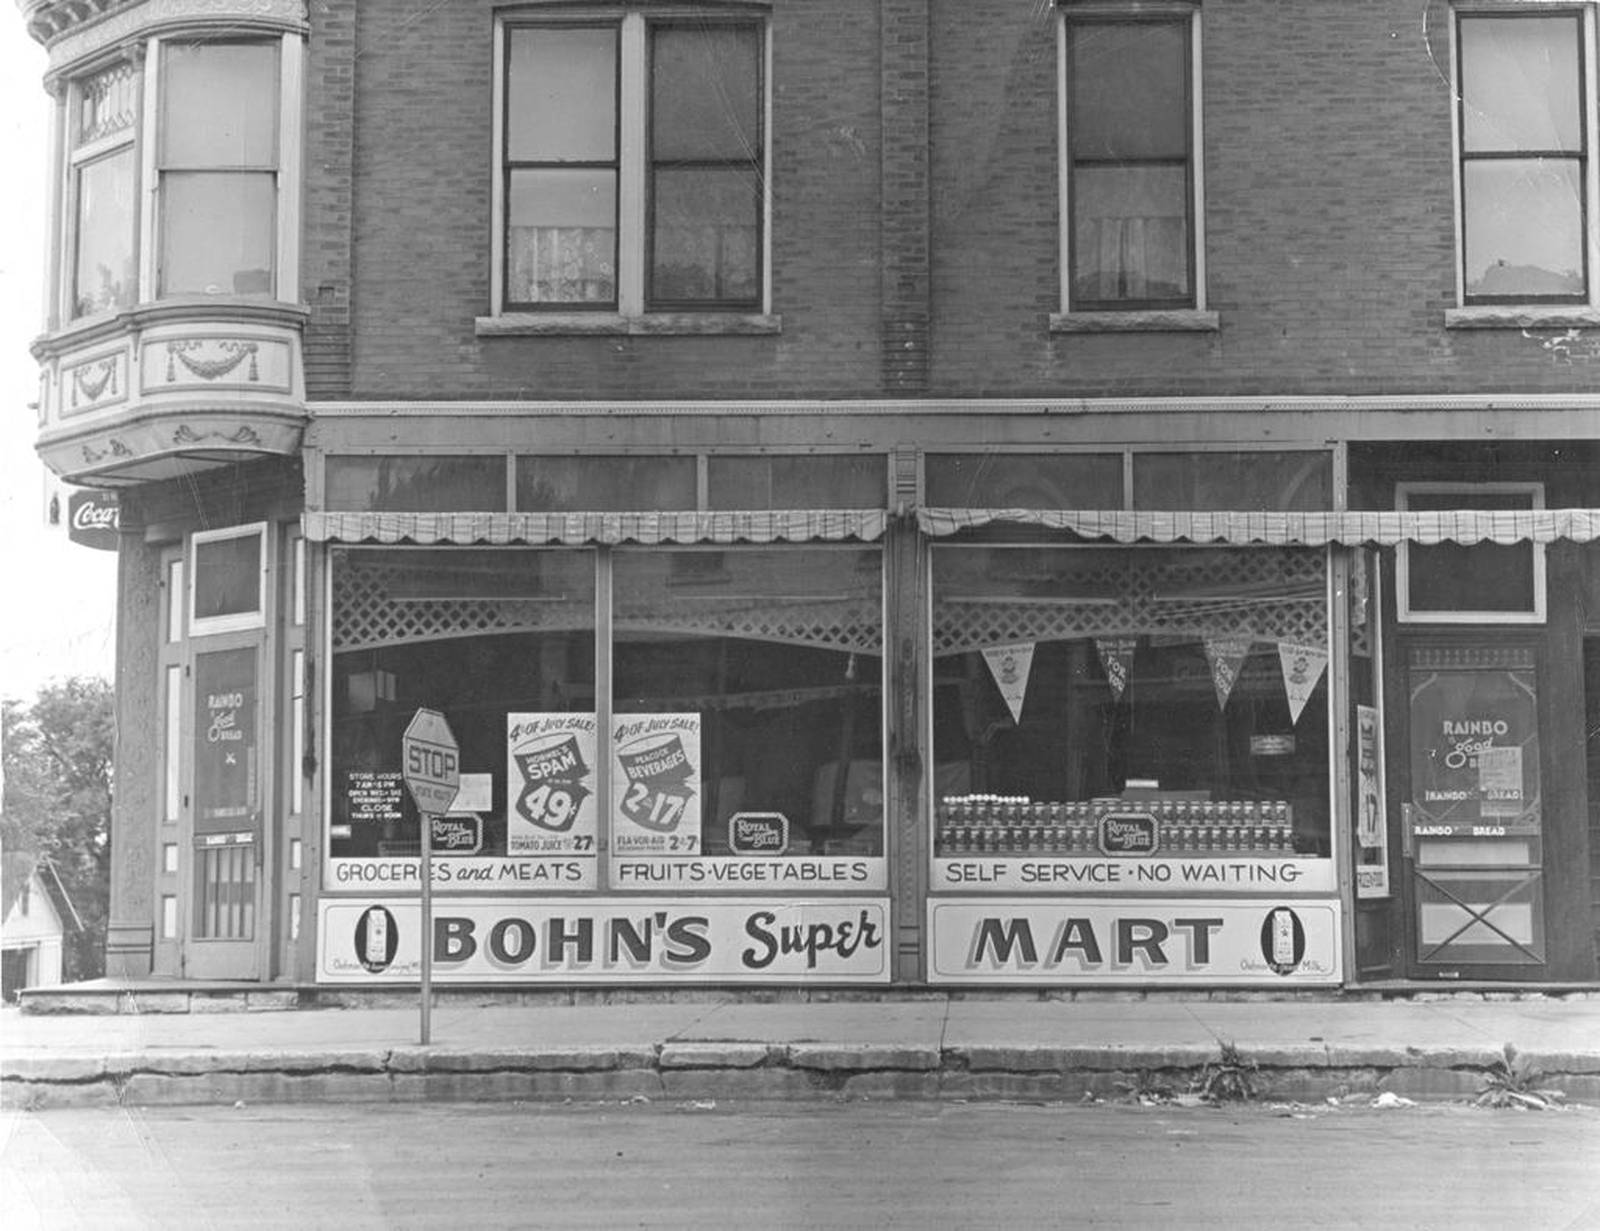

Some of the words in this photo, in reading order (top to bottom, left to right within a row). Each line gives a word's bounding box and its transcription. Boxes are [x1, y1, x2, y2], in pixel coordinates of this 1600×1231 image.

[1443, 721, 1508, 735] RAINBO
[409, 745, 456, 780] STOP
[527, 751, 577, 780] SPAM
[626, 750, 686, 780] BEVERAGES
[431, 819, 466, 835] ROYAL
[736, 820, 769, 835] ROYAL
[1107, 820, 1140, 836] ROYAL
[511, 840, 541, 851] TOMATO
[541, 840, 563, 851] JUICE
[1122, 831, 1151, 849] BLUE
[337, 863, 451, 882] GROCERIES
[457, 863, 493, 882] and
[499, 862, 582, 882] MEATS
[945, 863, 1007, 882] SELF
[1020, 863, 1121, 883] SERVICE
[1138, 864, 1171, 882] NO
[1181, 863, 1304, 883] WAITING
[433, 911, 712, 968] BOHN'S
[742, 910, 882, 970] Super
[967, 917, 1224, 969] MART
